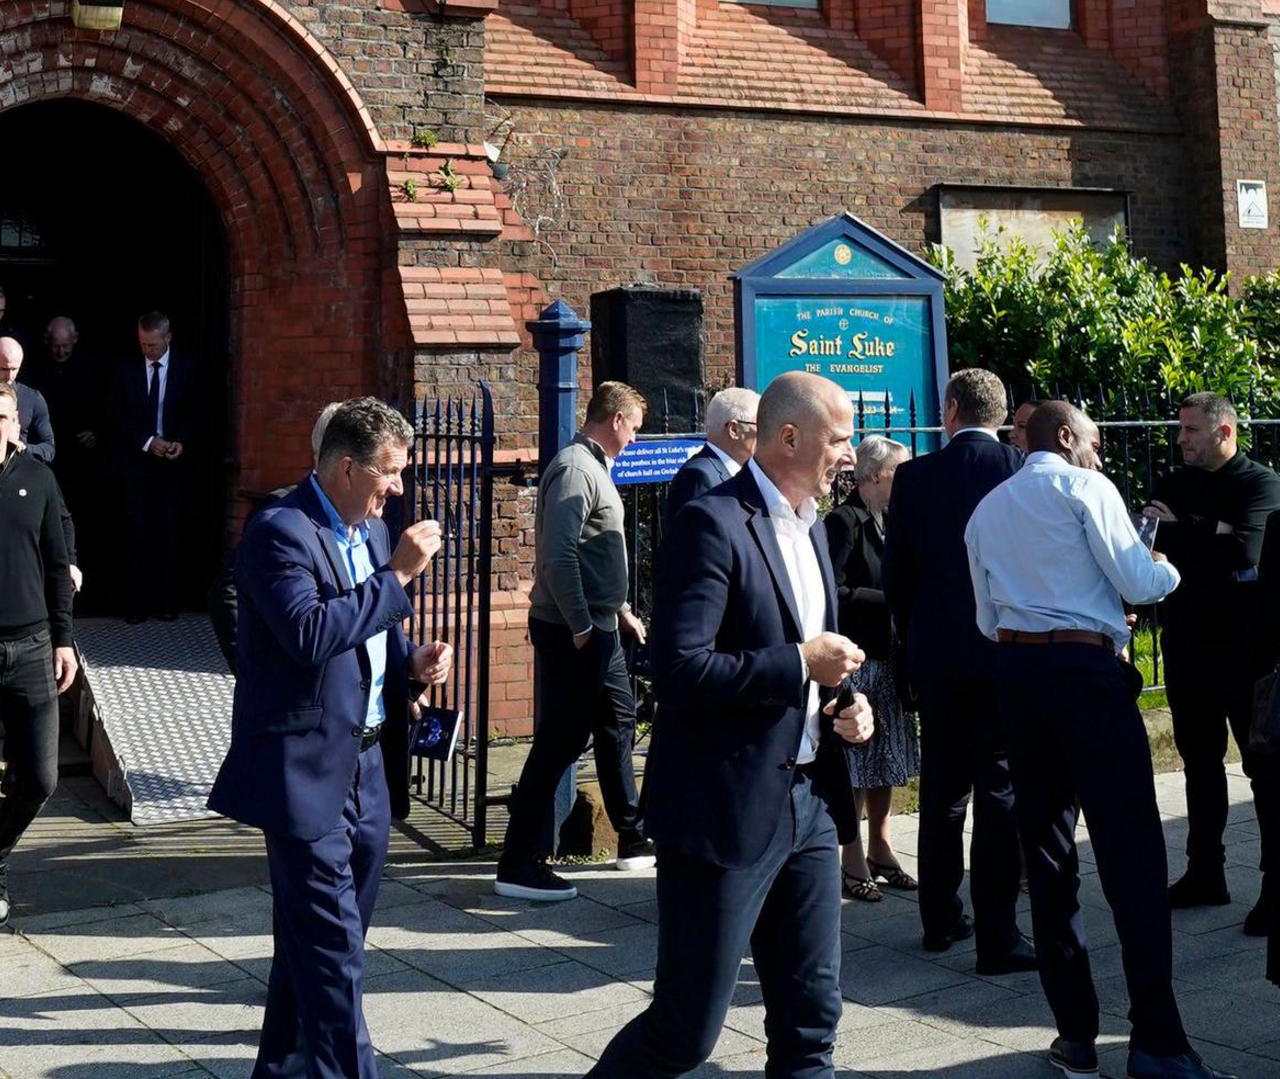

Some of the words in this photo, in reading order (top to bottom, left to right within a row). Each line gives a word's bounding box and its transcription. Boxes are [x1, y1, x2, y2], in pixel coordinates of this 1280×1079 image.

[797, 312, 811, 321] THE
[816, 308, 844, 317] PARISH
[849, 308, 880, 320] CHURCH
[883, 316, 894, 325] OF
[789, 328, 842, 357] Saint
[847, 331, 895, 360] Luke
[805, 363, 821, 373] THE
[830, 364, 884, 374] EVANGELIST
